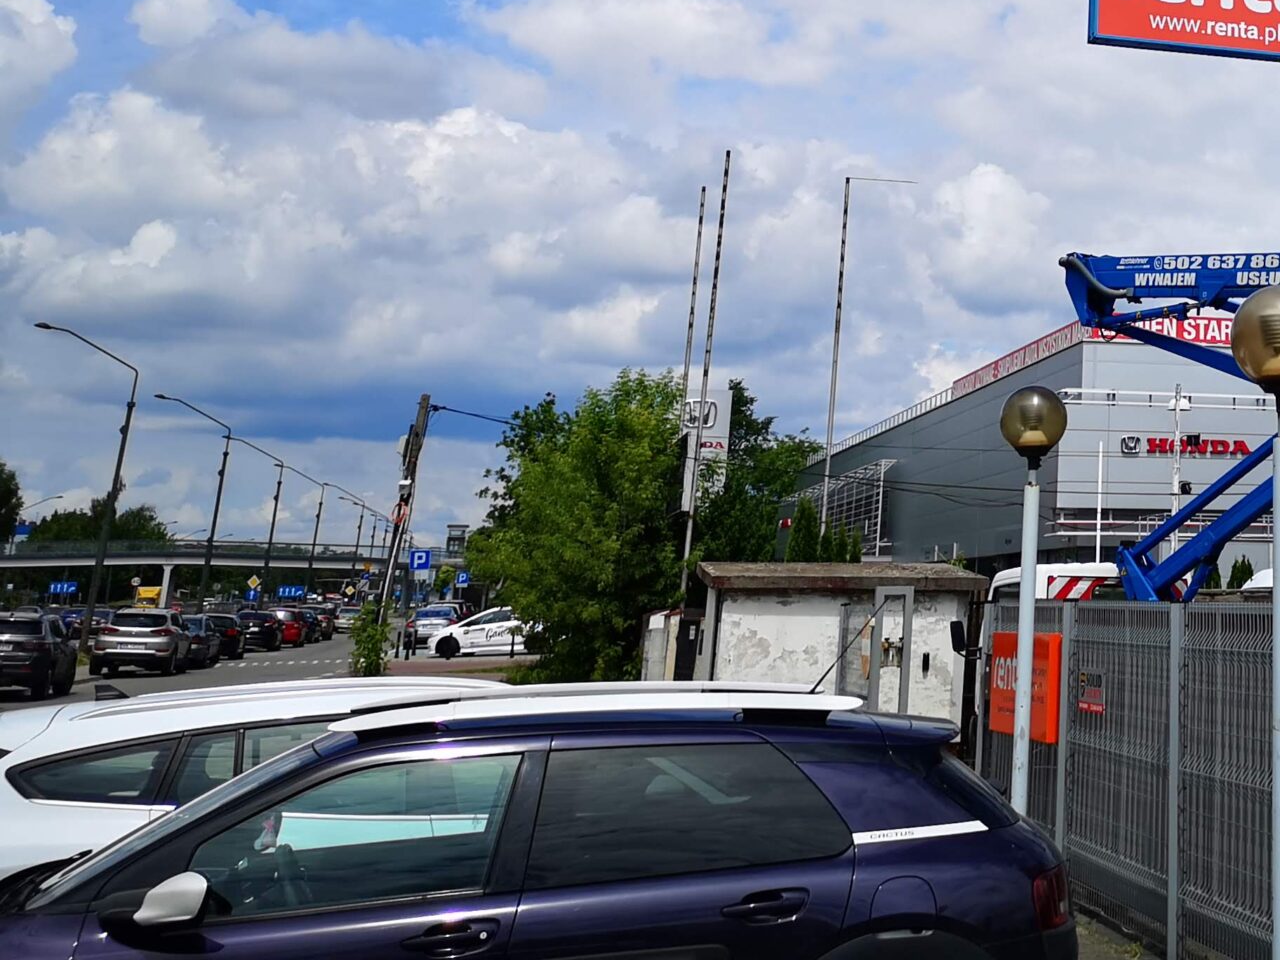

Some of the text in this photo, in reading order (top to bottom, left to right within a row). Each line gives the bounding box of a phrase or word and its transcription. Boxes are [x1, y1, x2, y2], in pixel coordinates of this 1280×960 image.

[1163, 256, 1203, 270] 502
[1207, 255, 1246, 269] 637
[1134, 272, 1196, 287] WYNAJEM
[1183, 318, 1233, 341] STAR
[1147, 438, 1252, 455] HONDA
[413, 552, 426, 568] P
[993, 651, 1018, 690] rent
[870, 830, 915, 839] CACTUS
